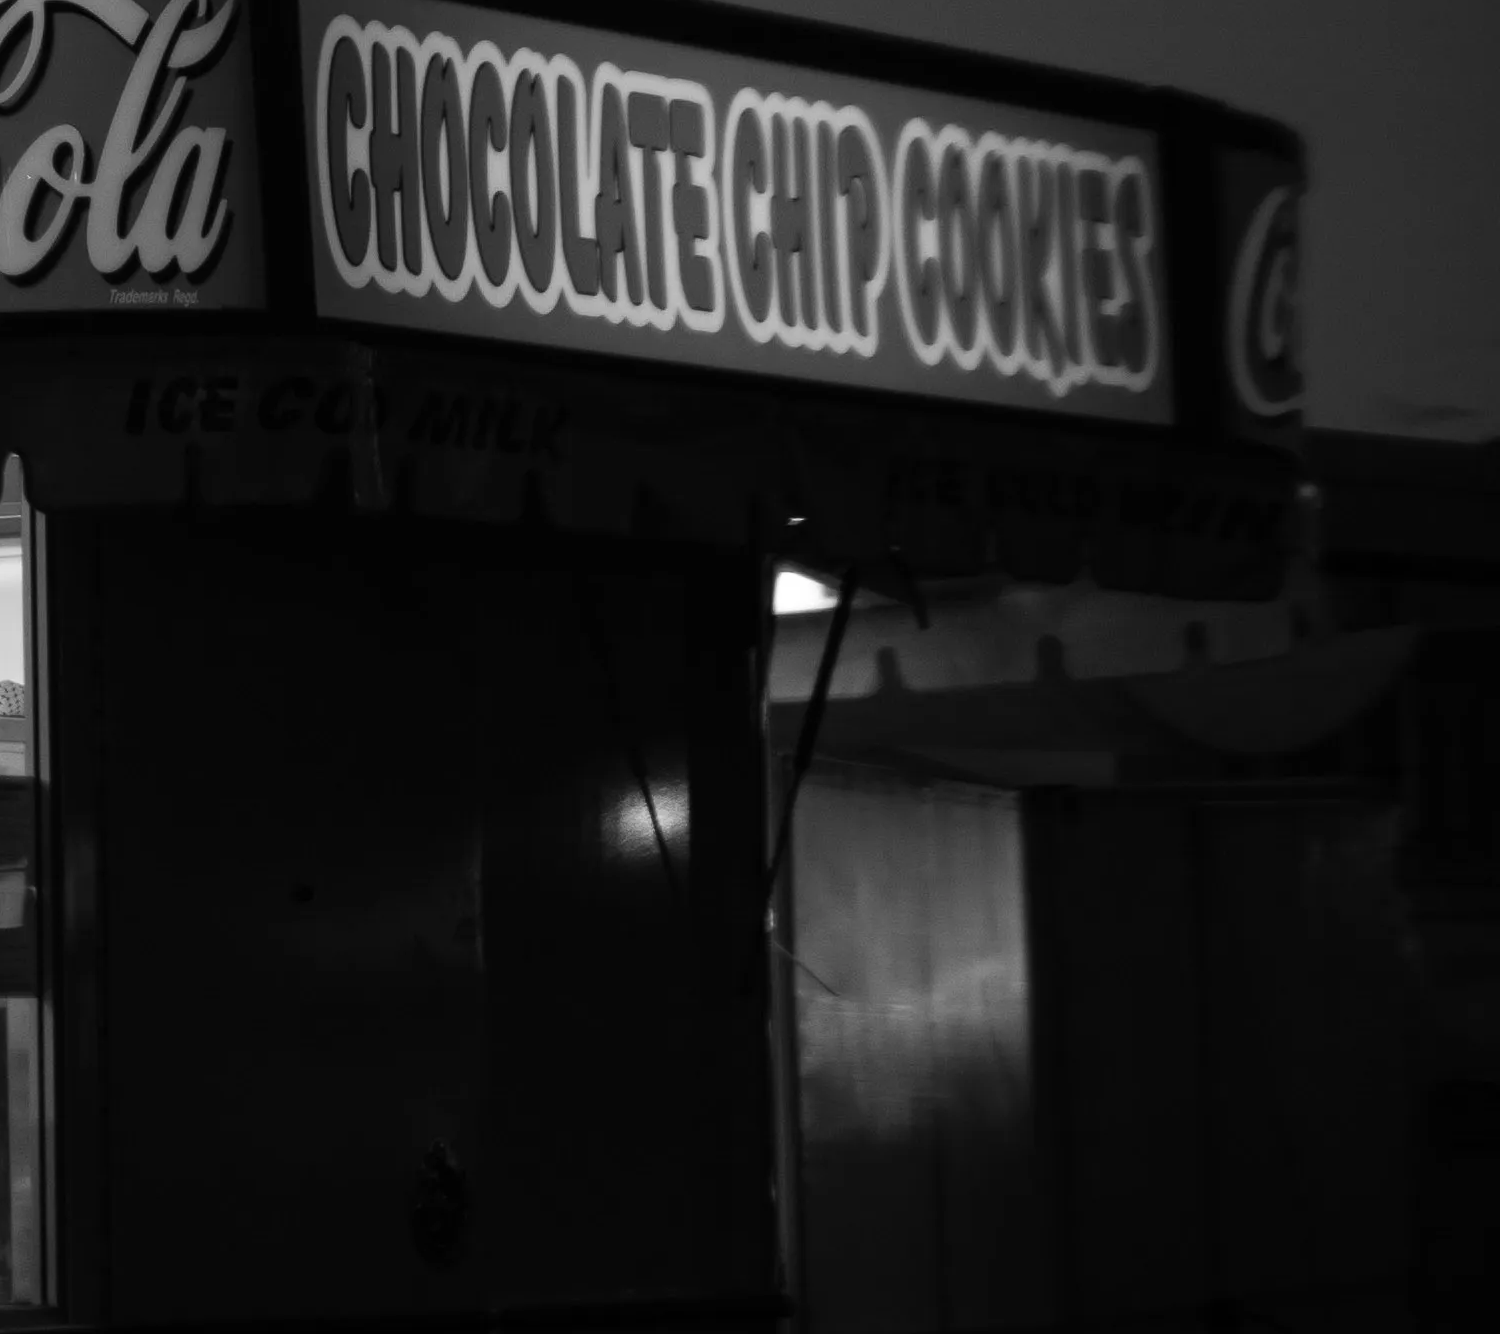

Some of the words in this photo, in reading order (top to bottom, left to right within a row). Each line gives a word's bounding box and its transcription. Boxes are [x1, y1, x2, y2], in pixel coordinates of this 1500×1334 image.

[317, 14, 724, 332] CHOCOLATE
[725, 86, 888, 357] CHIP
[892, 117, 1159, 397] COOKIES
[123, 375, 239, 436] ICE
[407, 384, 572, 463] MILK
